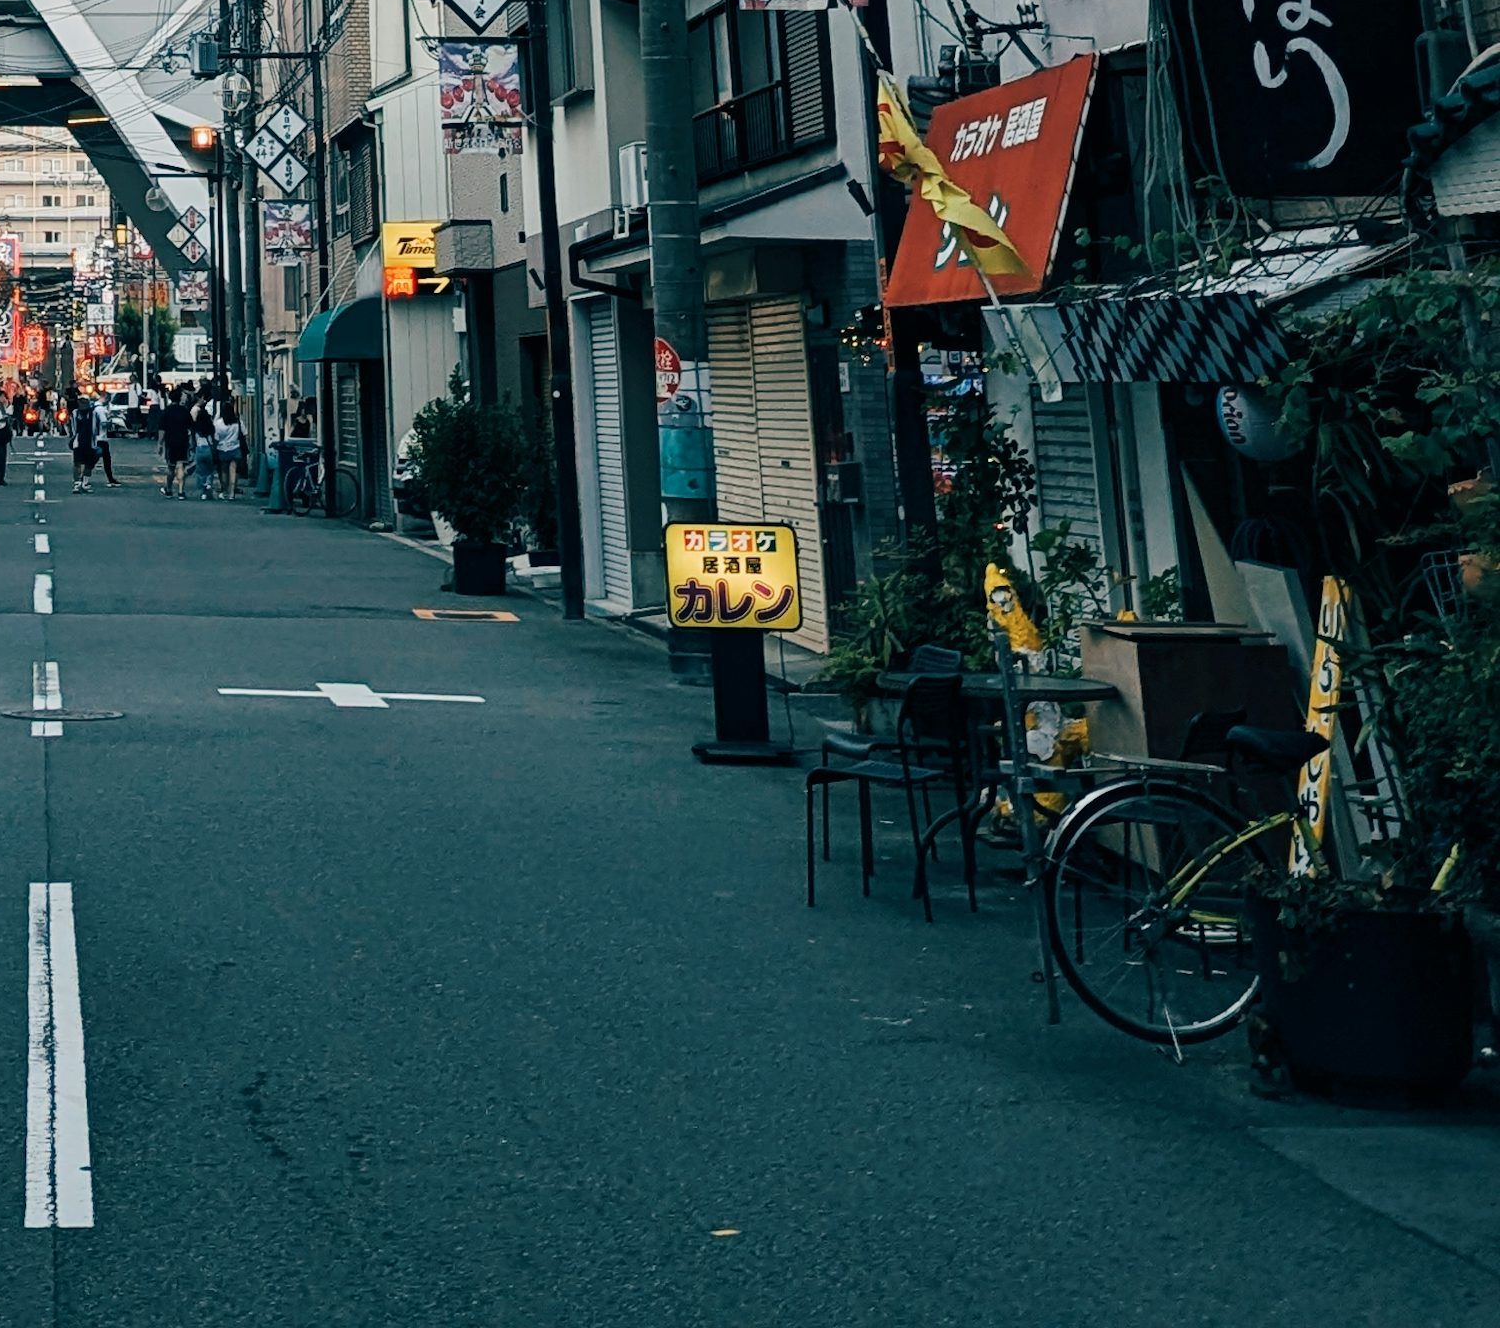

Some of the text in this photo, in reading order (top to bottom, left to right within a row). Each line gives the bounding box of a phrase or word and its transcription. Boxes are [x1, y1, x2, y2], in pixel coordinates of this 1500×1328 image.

[950, 113, 1003, 164] カラオケ
[1001, 96, 1048, 149] 居酒屋
[685, 531, 775, 552] カラオケ
[702, 556, 762, 575] 居酒屋
[674, 577, 794, 624] カレン
